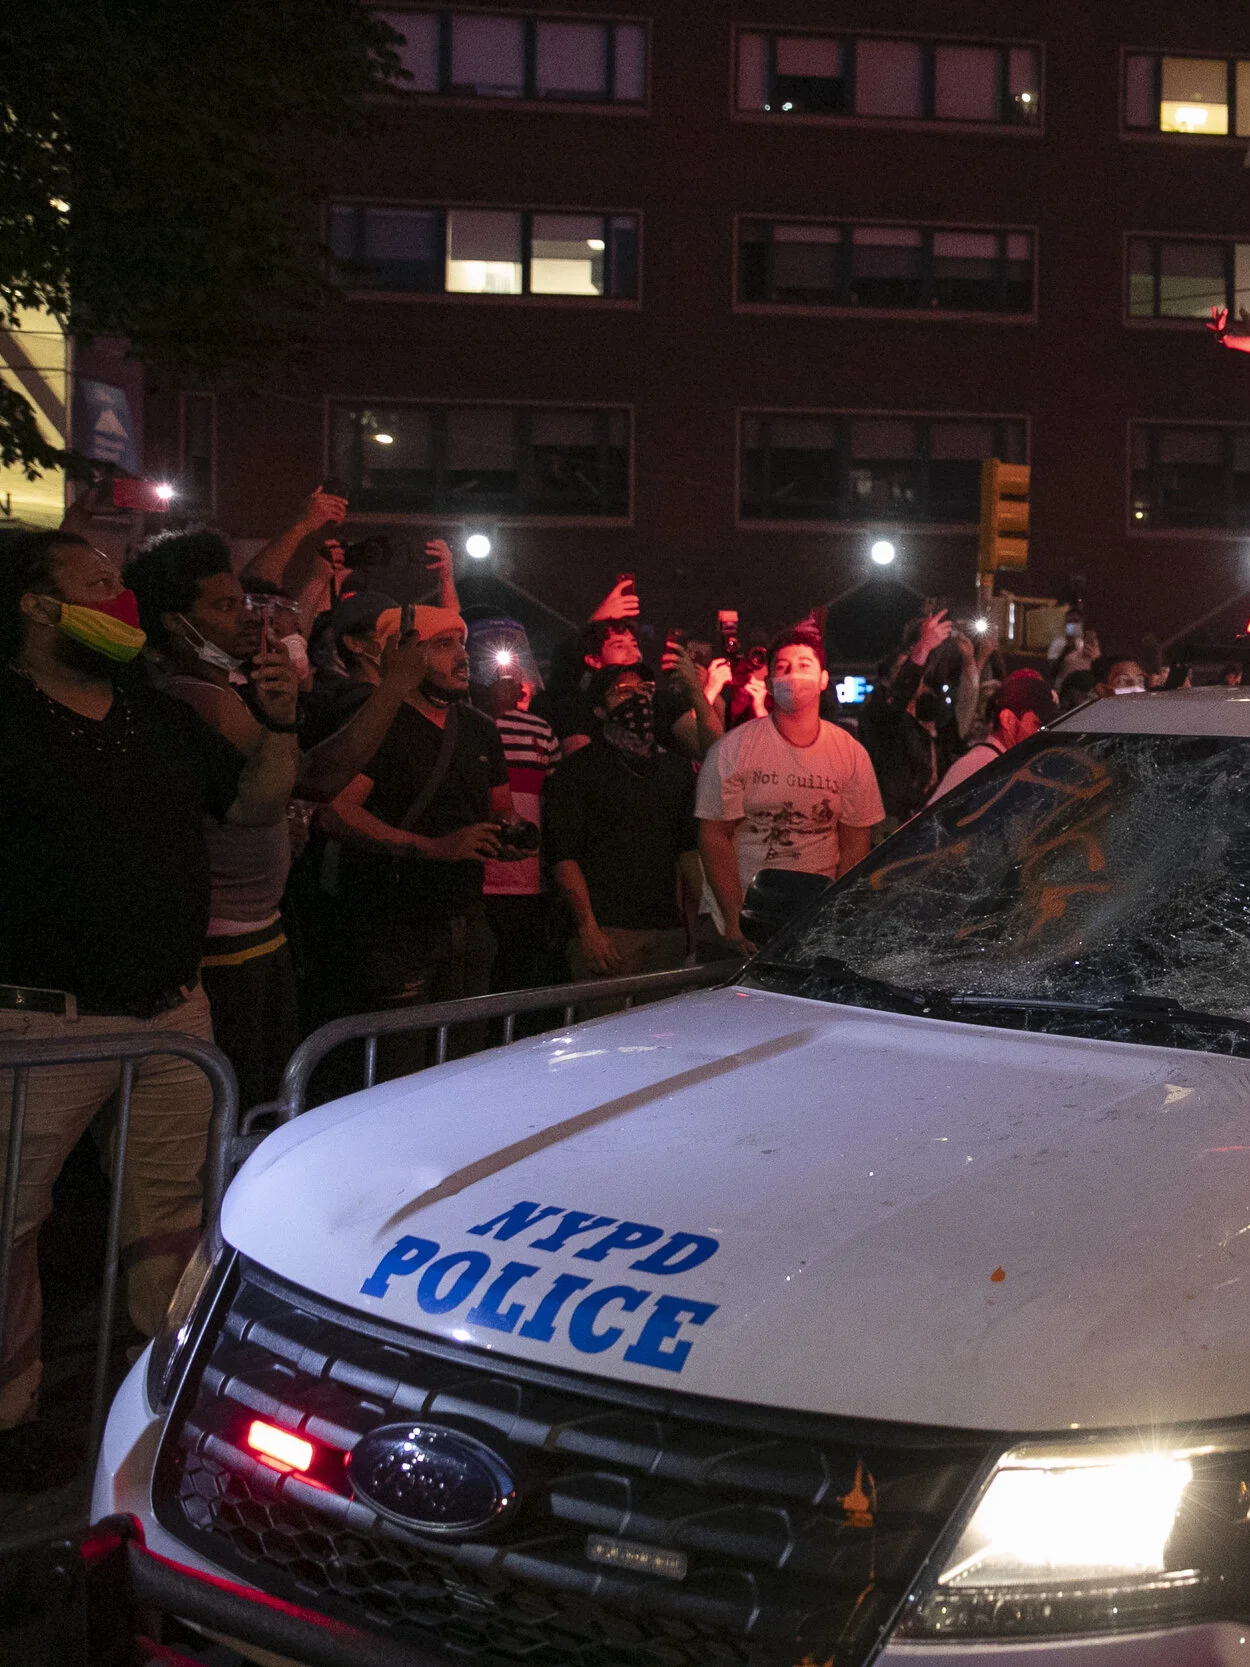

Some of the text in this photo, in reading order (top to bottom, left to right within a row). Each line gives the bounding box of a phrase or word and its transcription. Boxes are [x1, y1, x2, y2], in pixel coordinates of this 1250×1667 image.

[752, 771, 779, 785] Not
[467, 1200, 720, 1277] NYPD
[358, 1235, 720, 1374] POLICE
